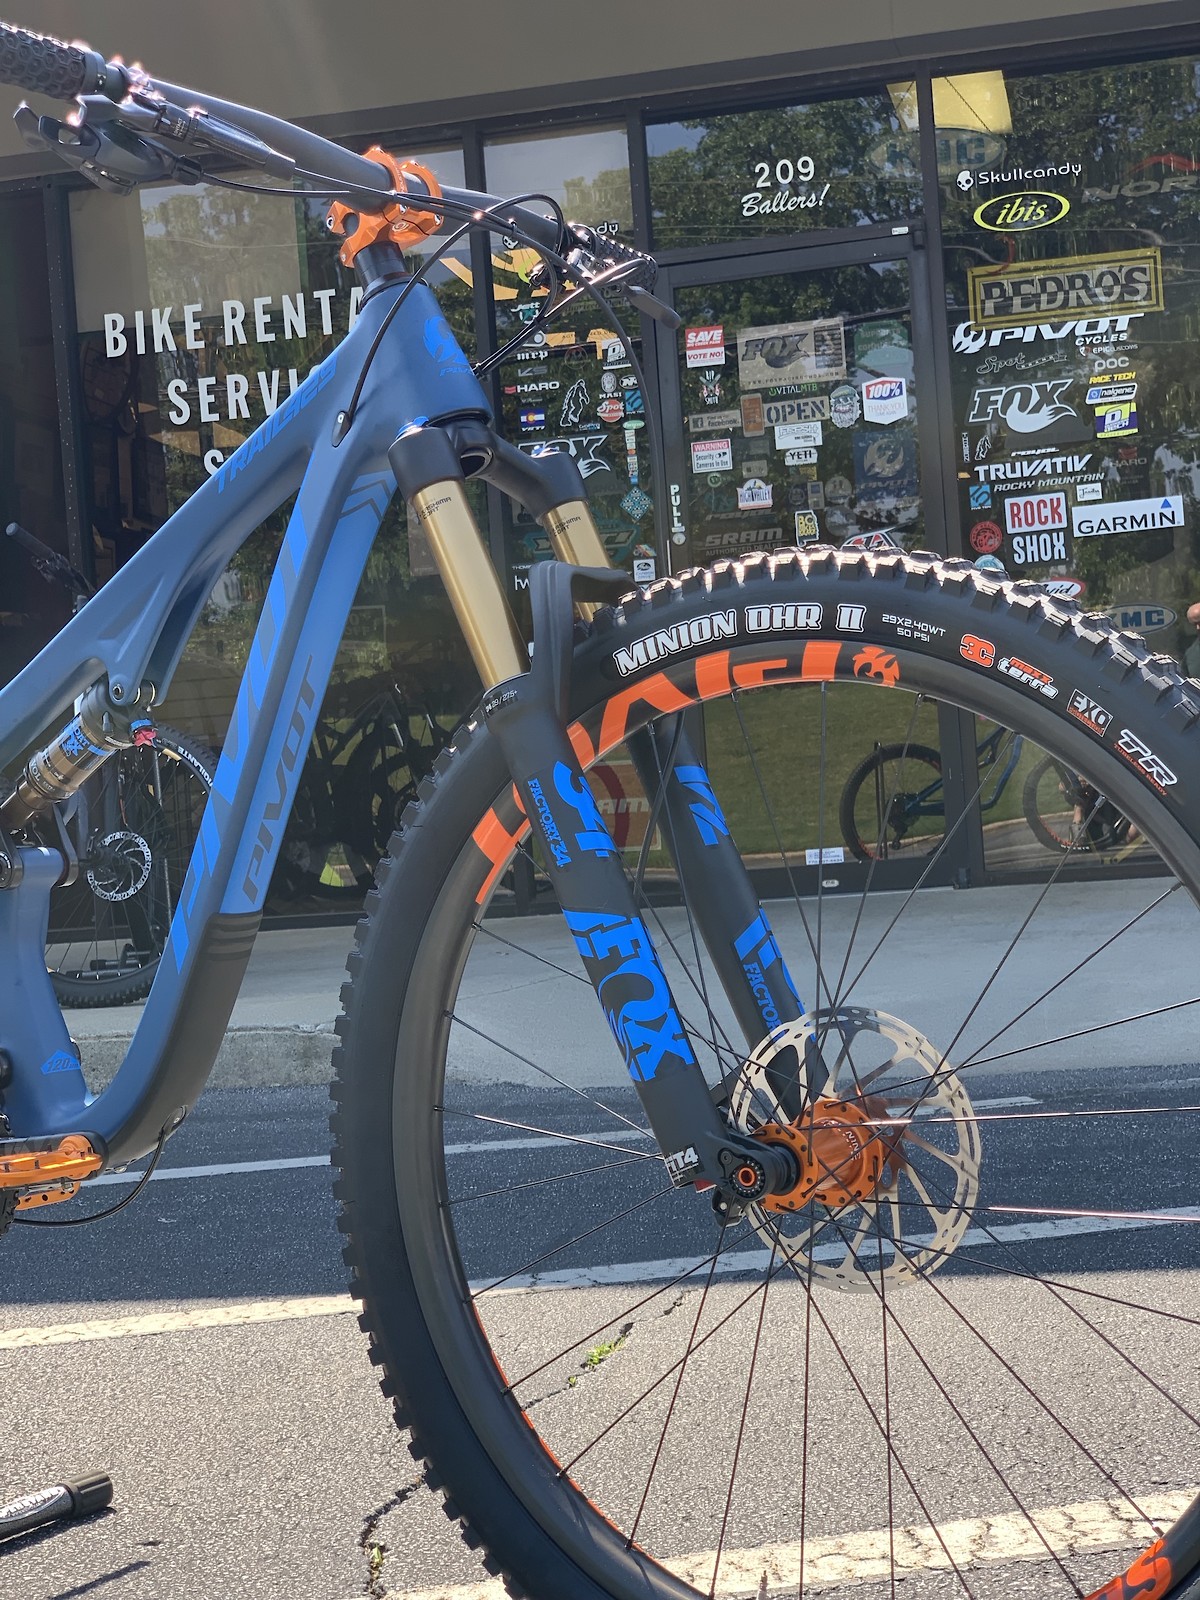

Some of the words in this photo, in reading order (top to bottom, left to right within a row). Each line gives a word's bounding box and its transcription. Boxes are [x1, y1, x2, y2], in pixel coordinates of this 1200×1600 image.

[754, 156, 815, 188] 209
[978, 162, 1082, 184] Skullcandy
[741, 184, 831, 217] Ballers!
[996, 197, 1048, 225] ibis
[982, 264, 1149, 316] PEDRO'S
[104, 303, 206, 358] BIKE
[687, 330, 722, 343] SAVE
[988, 313, 1145, 347] PIVOT
[1075, 332, 1128, 346] CYCLES
[742, 333, 809, 365] FOX
[517, 382, 559, 393] HARO
[868, 383, 901, 399] 100%
[1113, 372, 1136, 381] TECH
[167, 365, 321, 426] SERVI
[969, 378, 1076, 428] FOX
[766, 400, 826, 424] OPEN
[694, 441, 728, 452] WARNING
[789, 449, 812, 460] YETI
[974, 454, 1093, 482] TRUVATIV
[994, 481, 1036, 492] ROCKY
[1037, 472, 1105, 487] MOUNTAIN
[670, 485, 682, 528] PULL
[1009, 497, 1063, 529] ROCK
[1077, 510, 1176, 535] GARMIN
[1012, 532, 1066, 565] SHOX
[612, 608, 737, 677] MINION
[744, 602, 823, 634] DHR
[882, 613, 946, 638] 29X2.40WT
[896, 627, 912, 638] 50
[913, 630, 930, 643] PSI
[997, 657, 1059, 699] terra
[243, 656, 316, 904] PIVOT
[527, 778, 563, 846] FACTORY
[590, 917, 696, 1082] FOX
